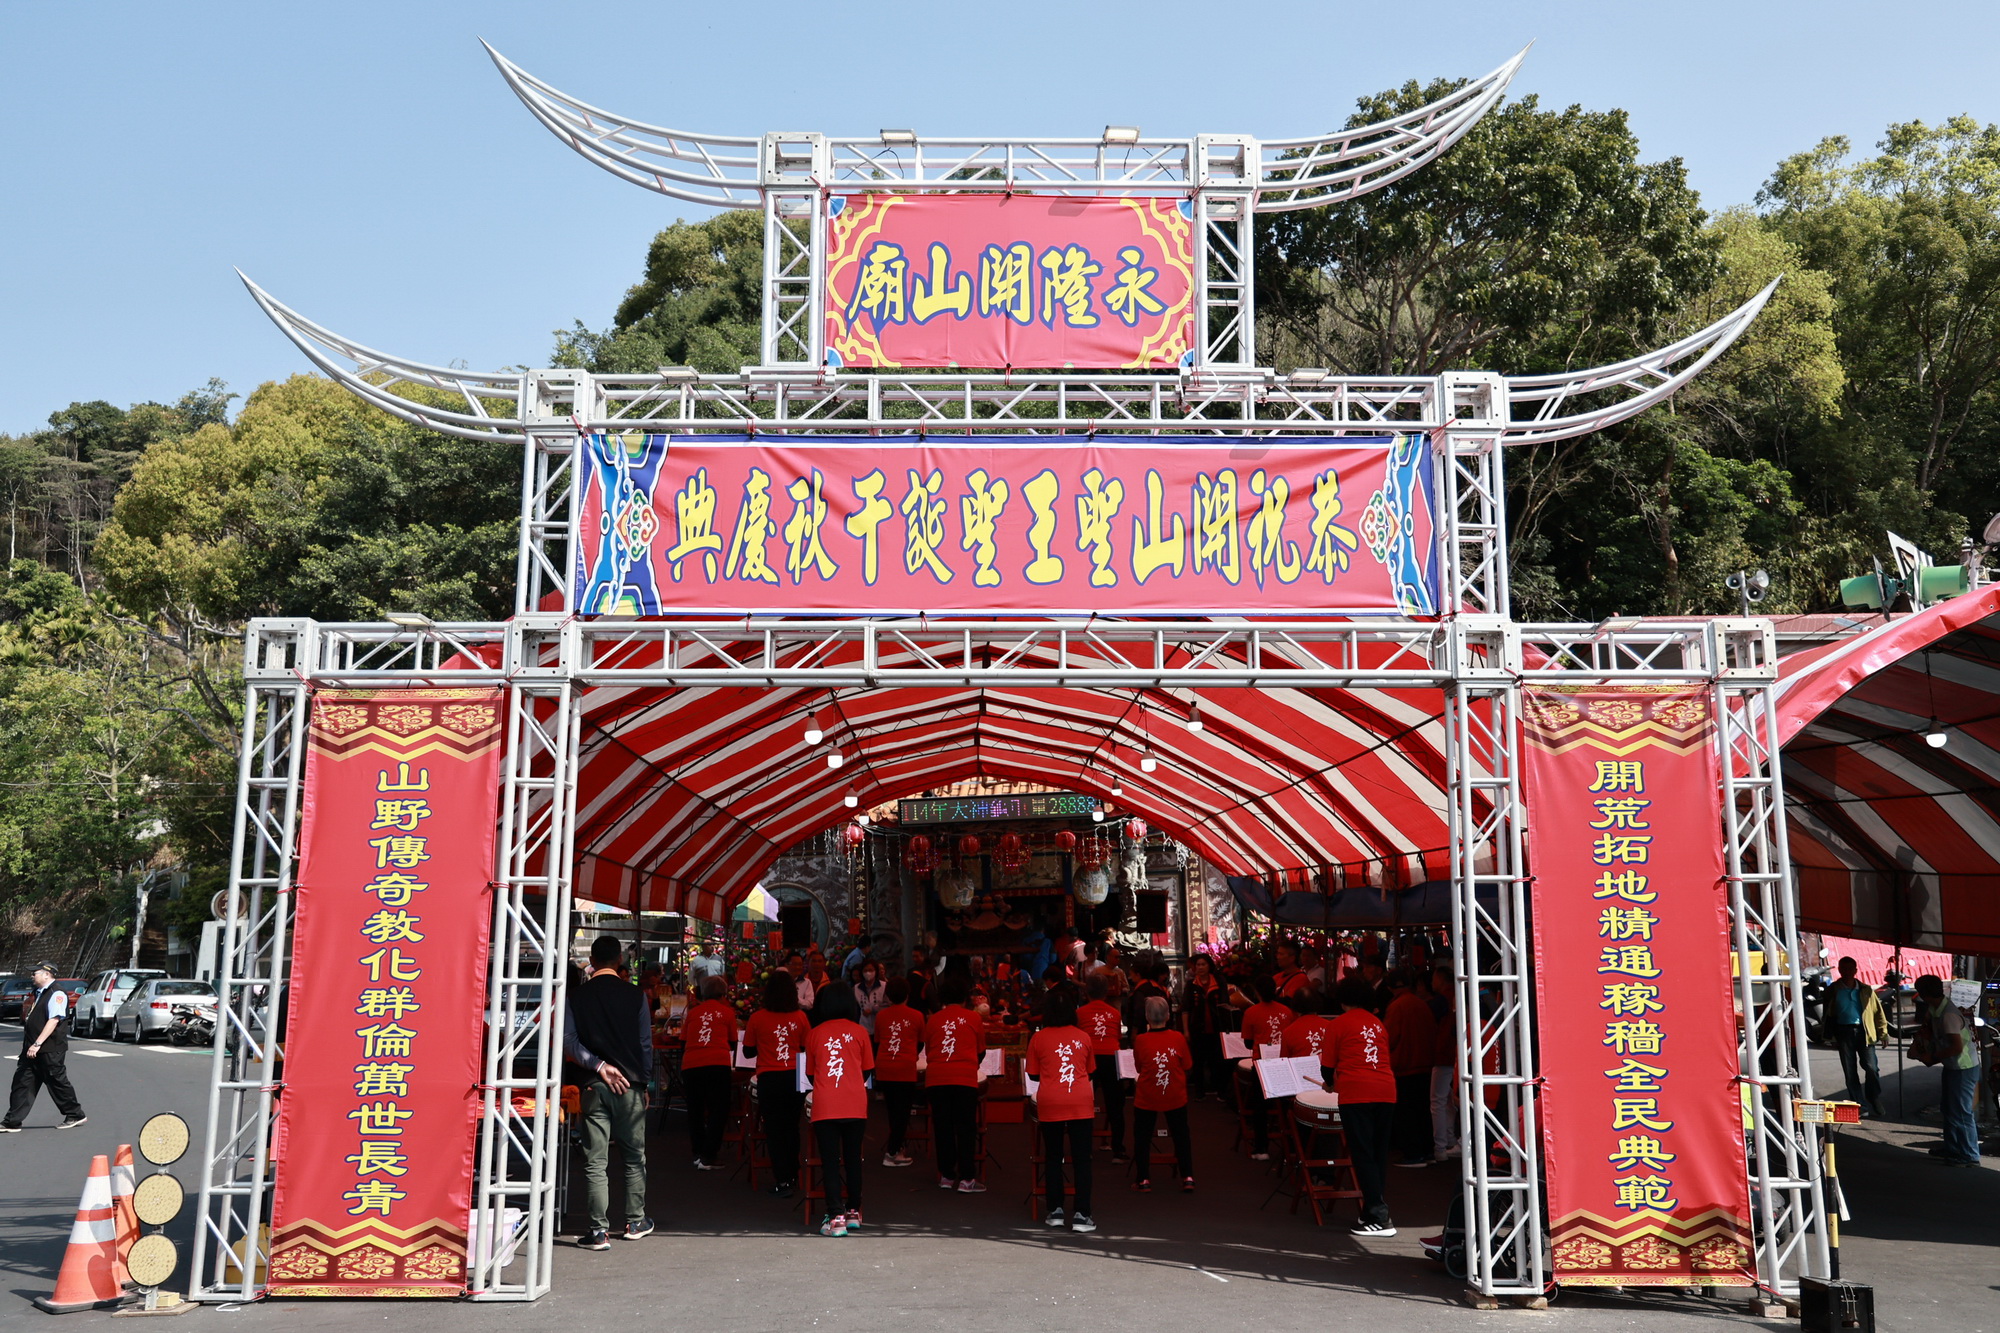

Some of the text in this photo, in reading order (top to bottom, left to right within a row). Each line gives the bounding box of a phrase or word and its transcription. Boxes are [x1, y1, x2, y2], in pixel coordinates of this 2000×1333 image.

[847, 241, 1166, 330] 永隆開山廟
[343, 762, 432, 1216] 山野傳奇教化群倫萬世長青
[1588, 760, 1678, 1213] 開荒拓地精通稼穡全民典範
